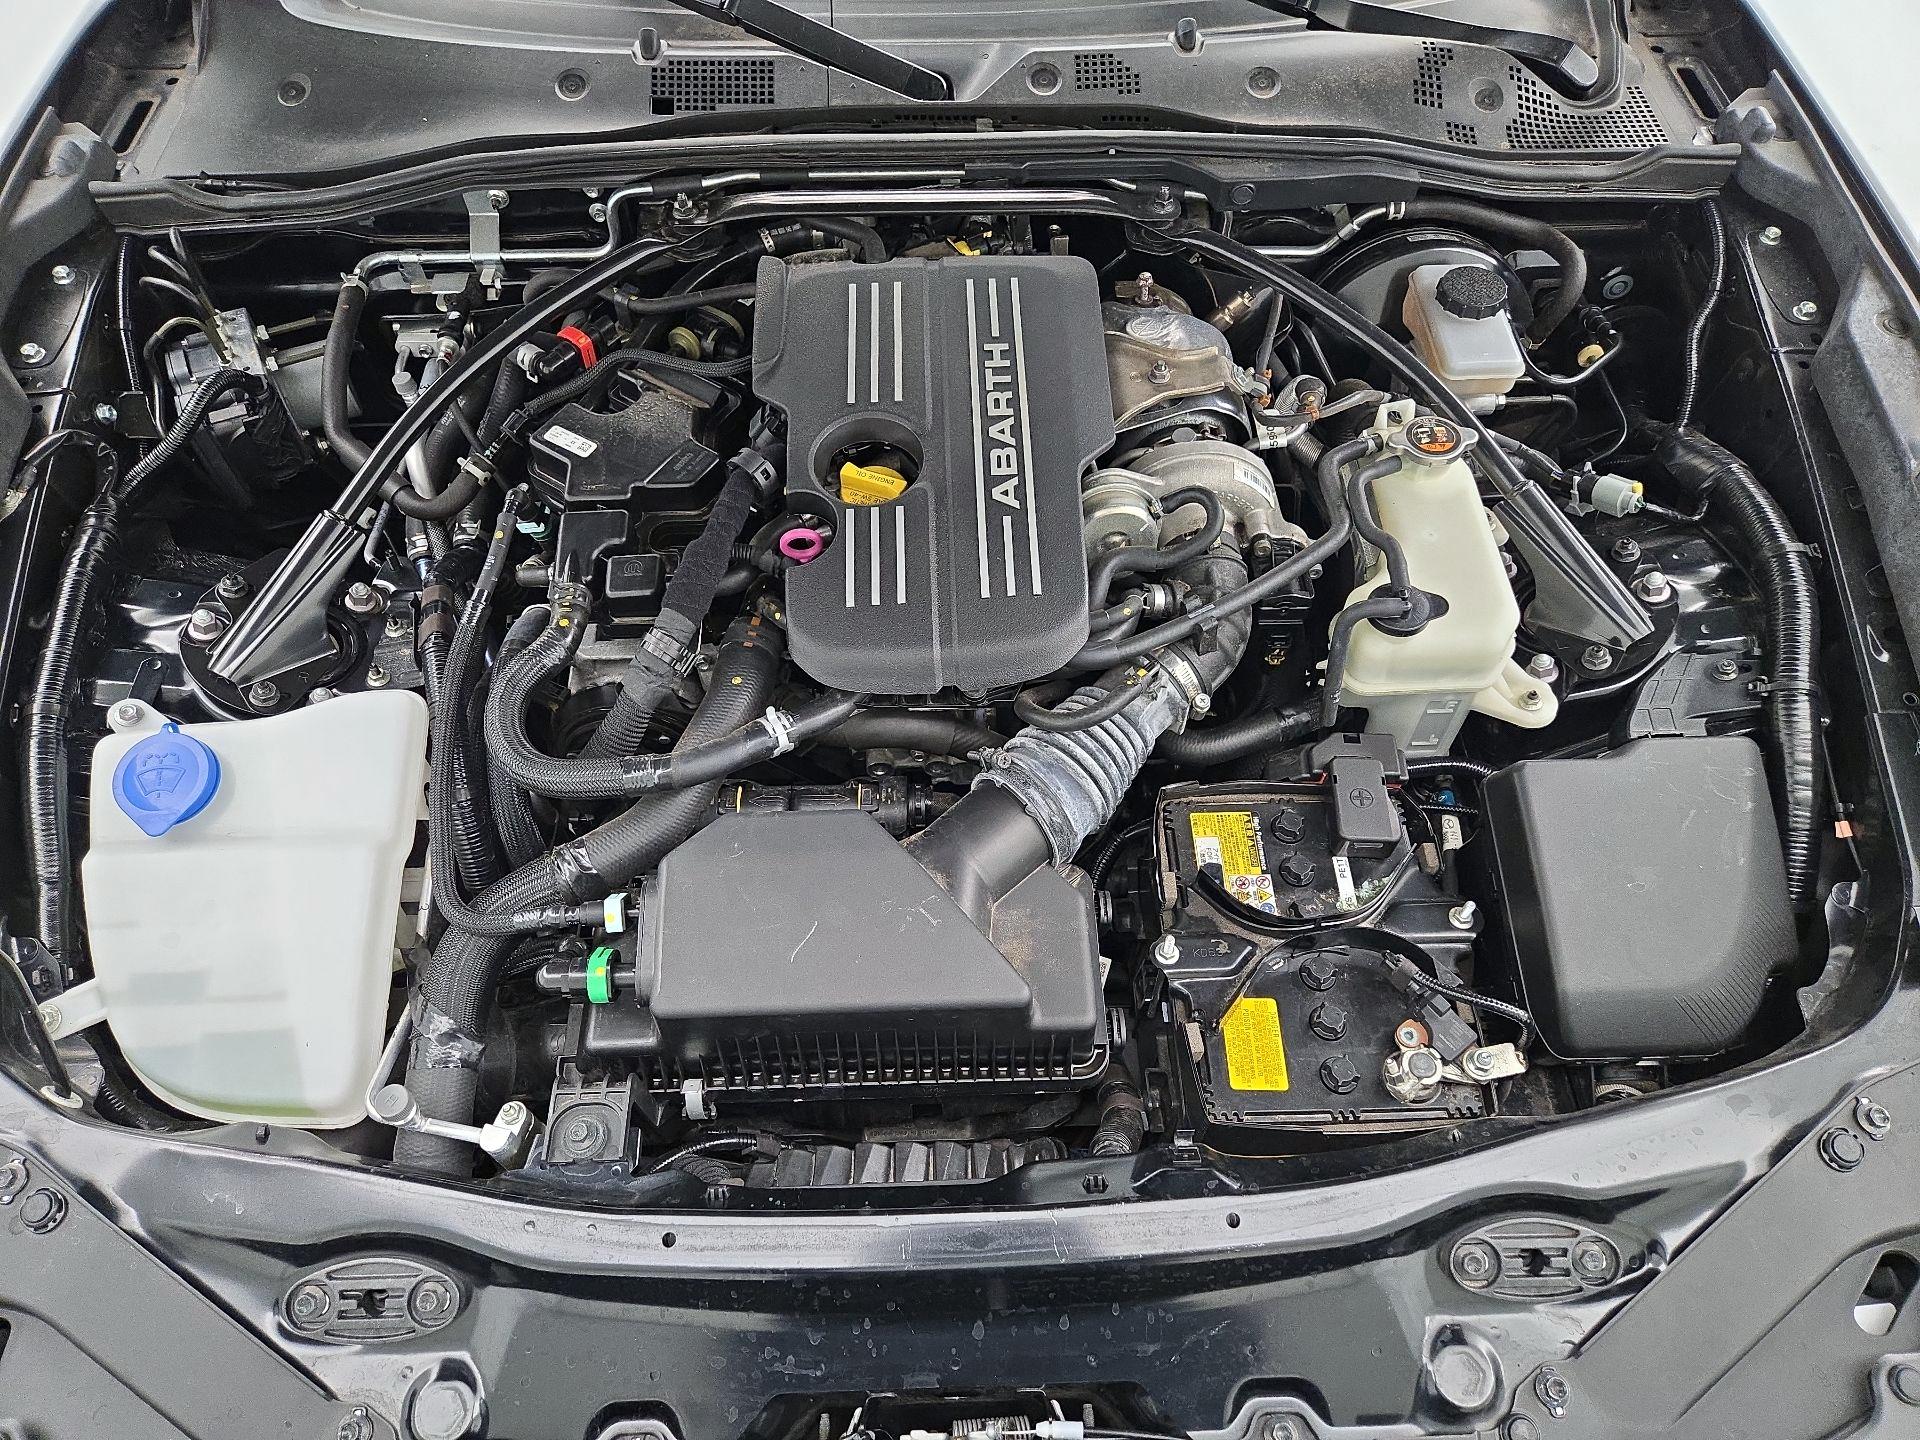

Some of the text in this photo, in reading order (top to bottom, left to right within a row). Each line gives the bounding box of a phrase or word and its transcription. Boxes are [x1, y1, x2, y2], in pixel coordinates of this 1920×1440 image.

[984, 343, 1020, 509] ABARTH
[855, 469, 895, 485] ENGINE OIL
[1252, 816, 1267, 870] High Performance
[1242, 1009, 1251, 1030] POISON
[1269, 1011, 1279, 1038] DANGER
